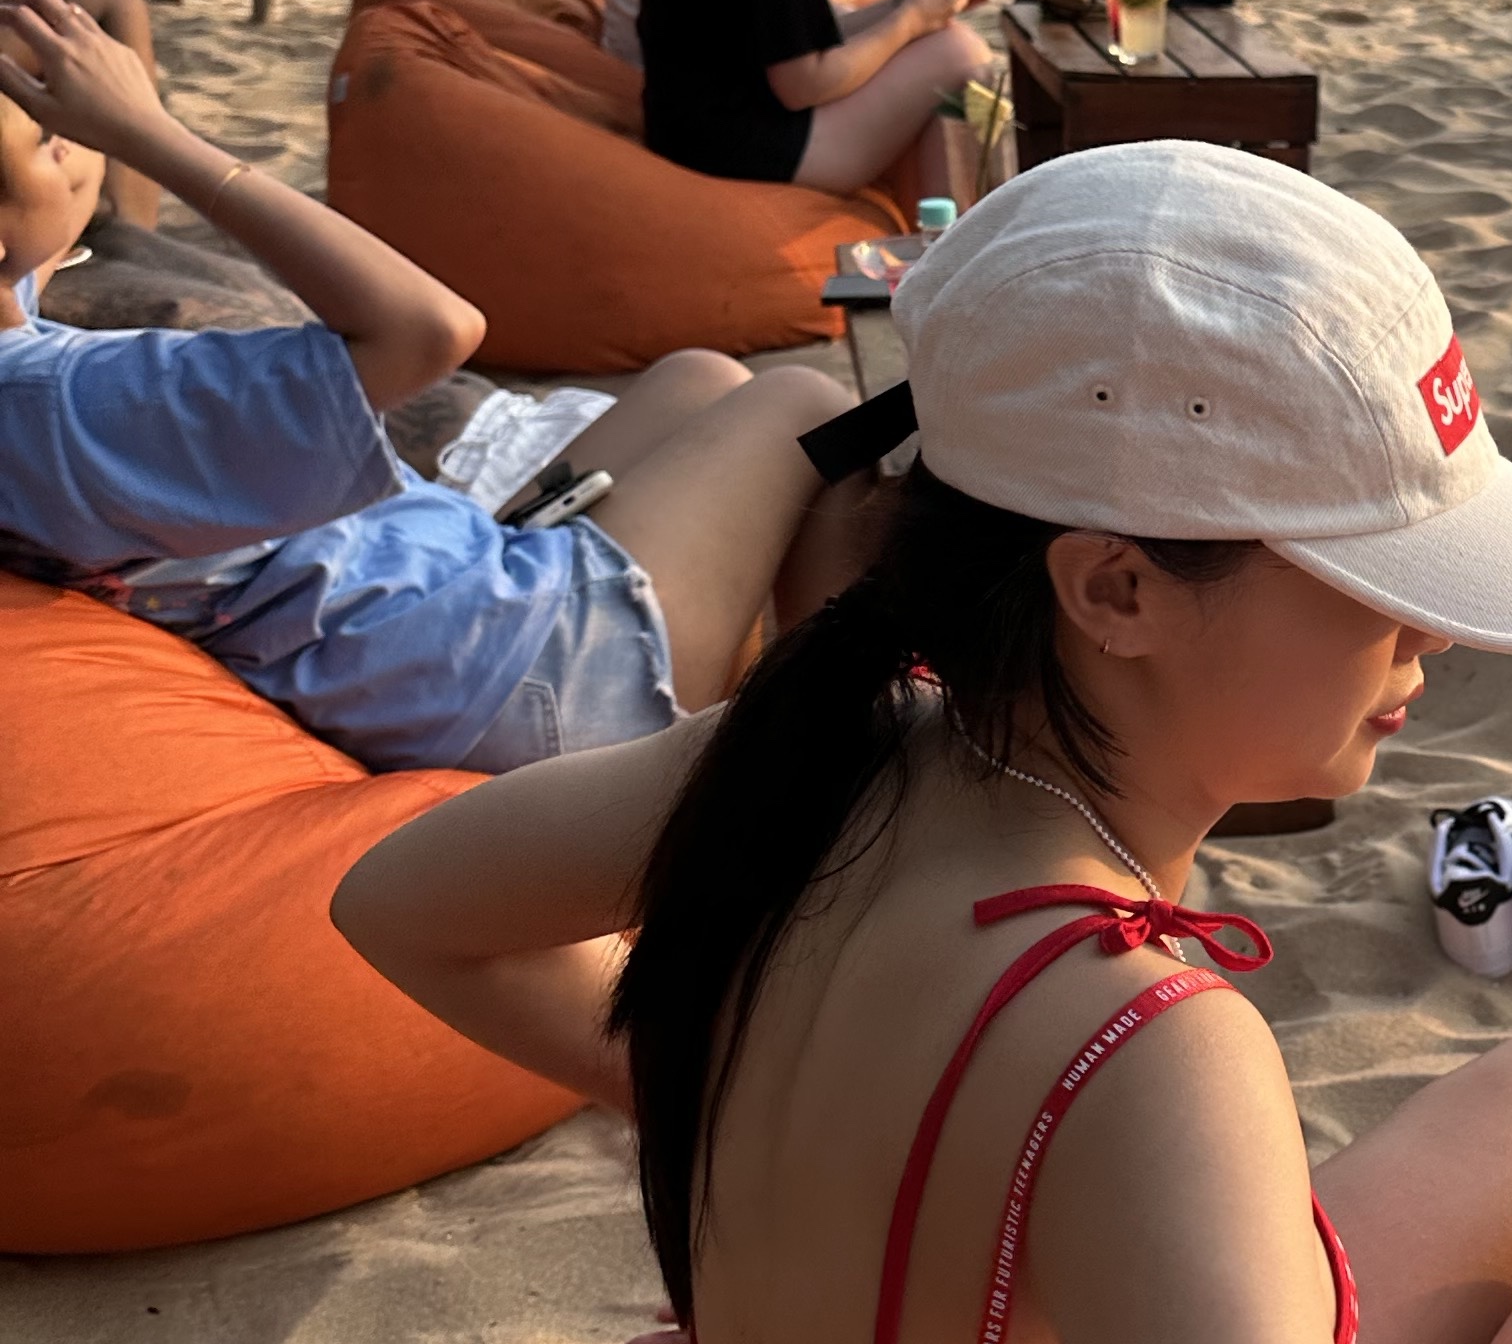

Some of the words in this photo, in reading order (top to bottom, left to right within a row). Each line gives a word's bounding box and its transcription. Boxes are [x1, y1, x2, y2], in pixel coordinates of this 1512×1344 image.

[1061, 1042, 1106, 1091] HUMAN
[1101, 1008, 1142, 1044] MADE
[1013, 1111, 1053, 1197] TEENAGERS
[996, 1199, 1021, 1288] FUTURISTIC
[990, 1289, 1009, 1319] FOR
